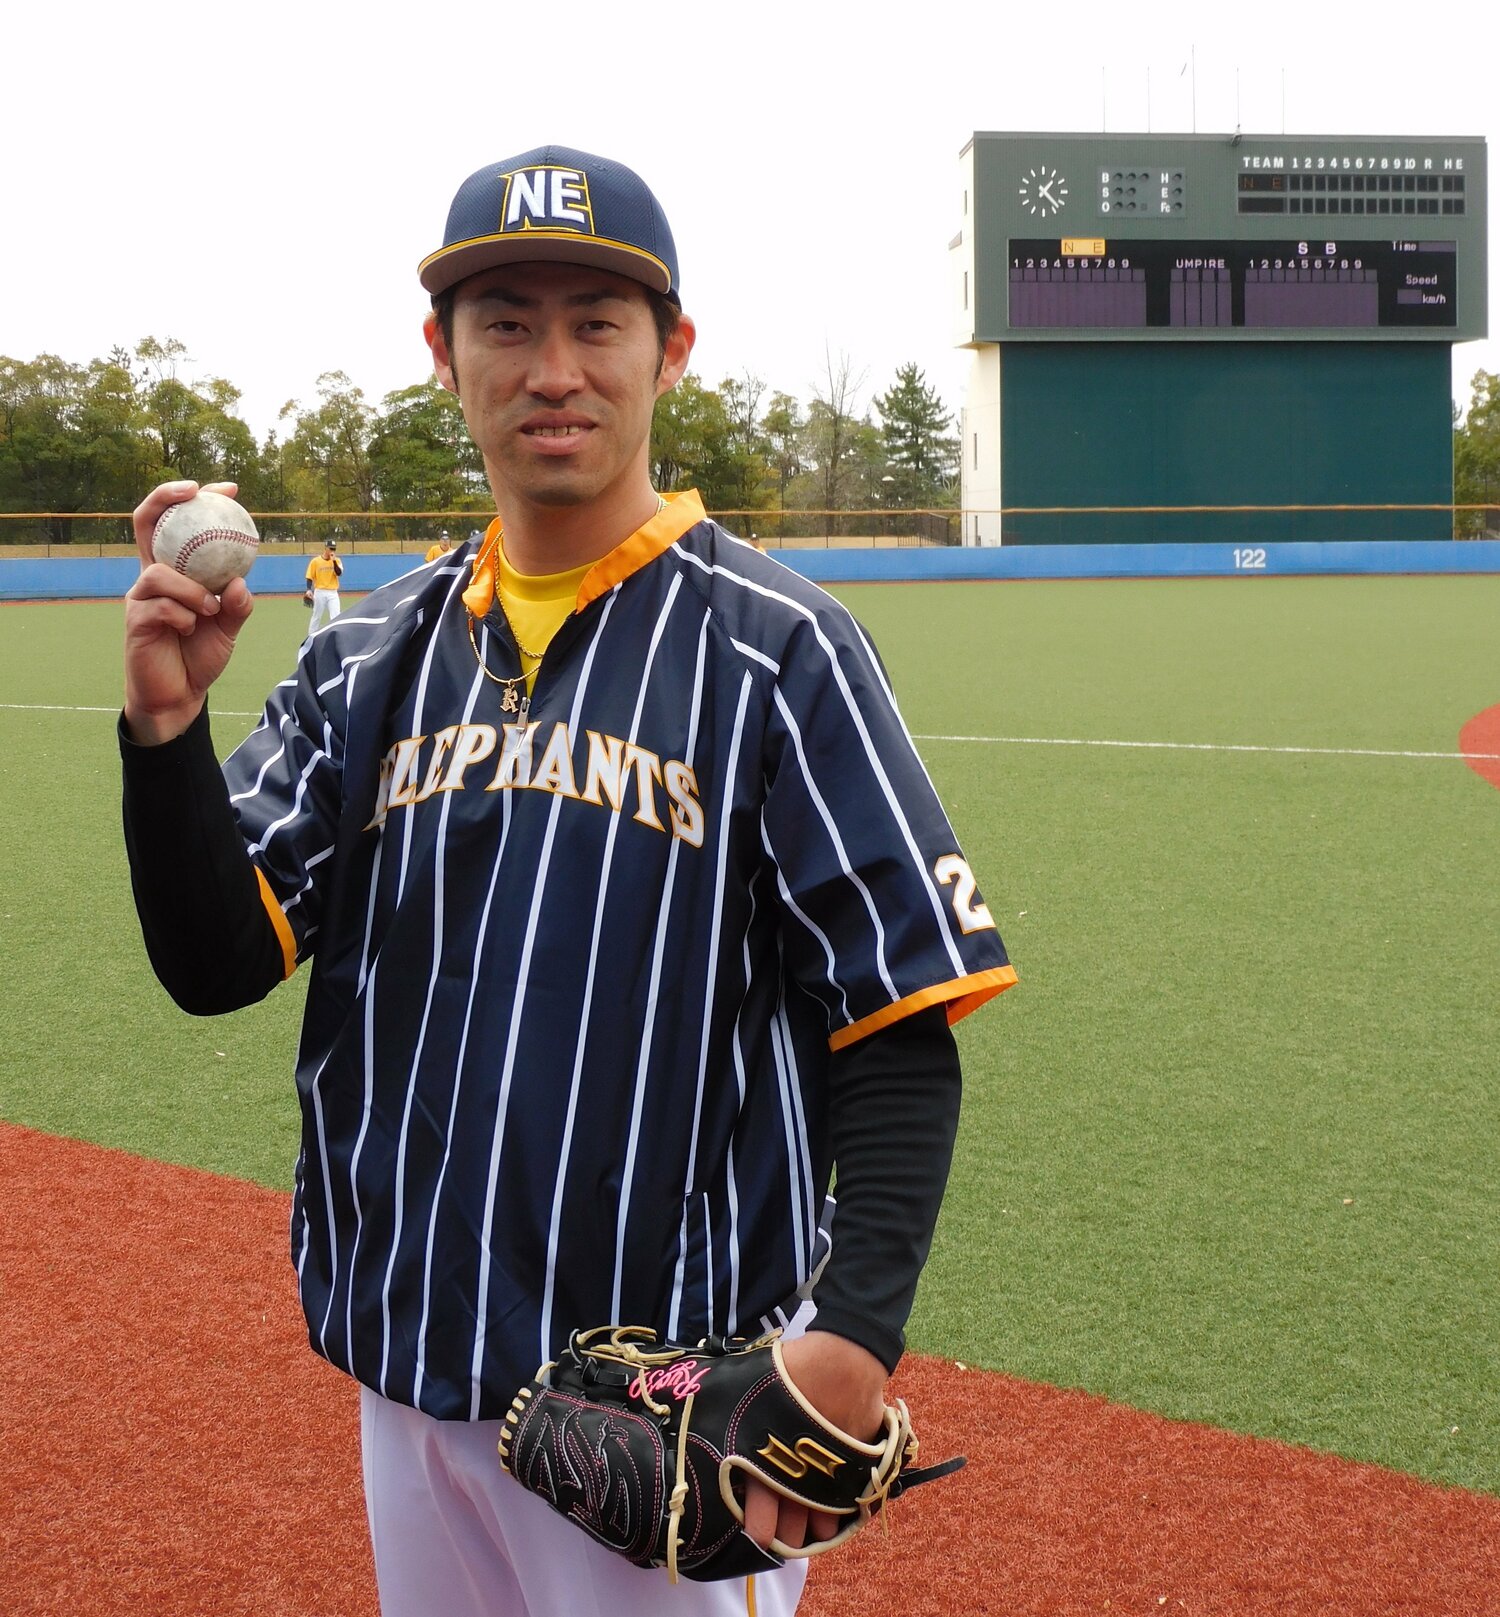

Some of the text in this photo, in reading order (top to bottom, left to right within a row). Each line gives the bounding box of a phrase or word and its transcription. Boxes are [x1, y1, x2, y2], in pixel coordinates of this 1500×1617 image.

[1243, 156, 1284, 168] TEAM
[1404, 158, 1416, 170] 10
[1101, 172, 1110, 183] B
[1161, 172, 1169, 184] H
[506, 170, 585, 225] NE
[1102, 187, 1110, 198] S
[1161, 187, 1169, 199] E
[1176, 259, 1225, 269] UMPIRE
[1405, 274, 1438, 286] Speed
[1422, 293, 1446, 304] km/h
[1233, 548, 1266, 569] 122
[933, 853, 997, 935] 2
